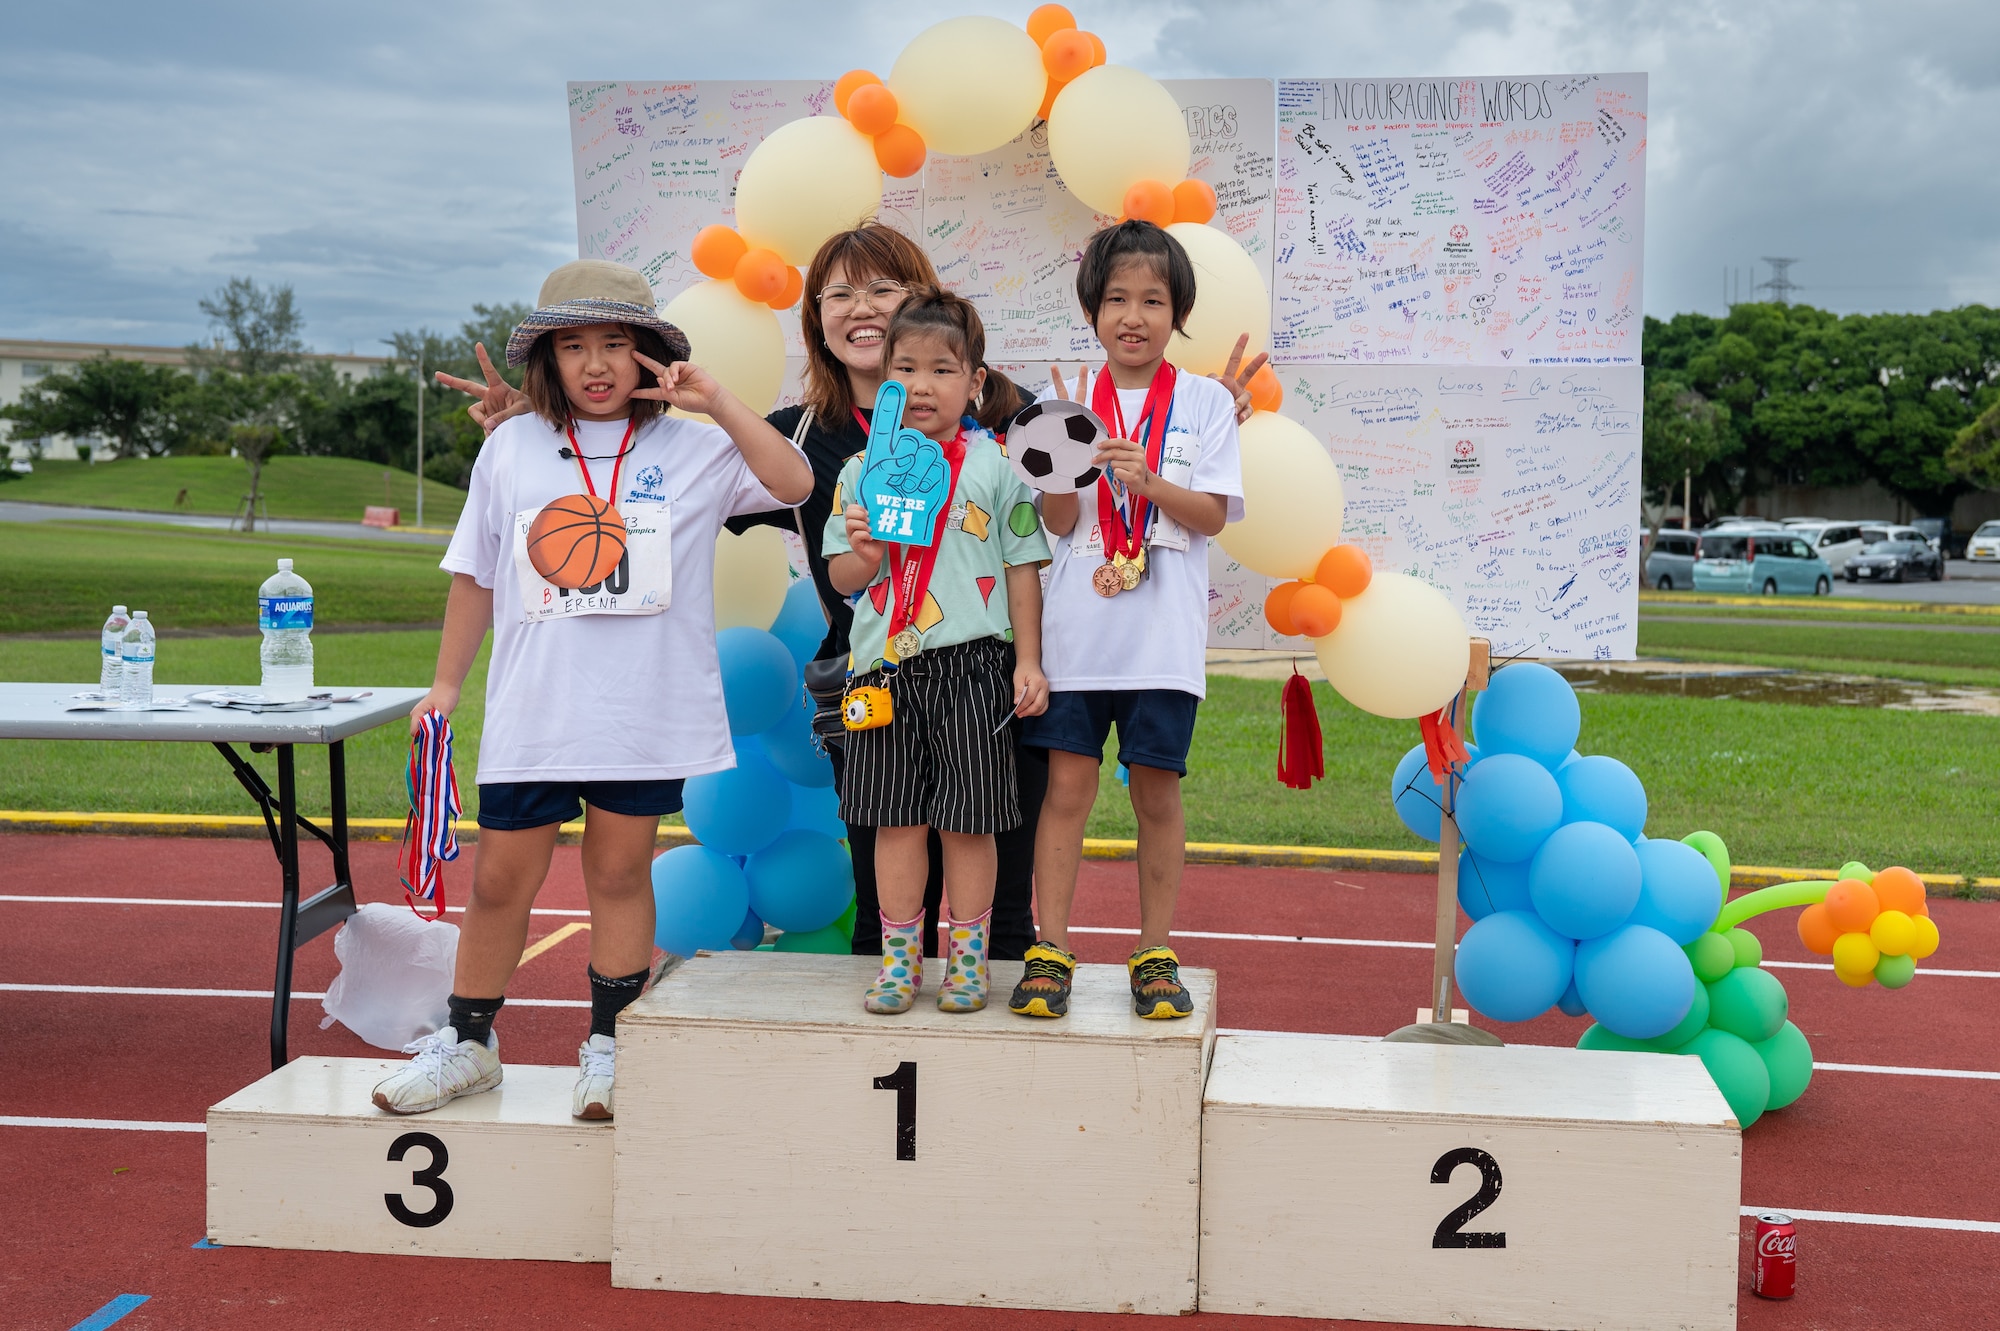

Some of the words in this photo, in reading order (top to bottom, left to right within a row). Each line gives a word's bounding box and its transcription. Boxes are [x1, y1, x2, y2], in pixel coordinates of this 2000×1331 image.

[626, 83, 639, 97] You
[643, 87, 657, 95] are
[1321, 81, 1460, 121] ENCOURAGING
[1480, 79, 1552, 122] WORDS
[1192, 140, 1244, 155] athletes
[694, 158, 708, 166] Hard
[1355, 153, 1370, 161] they
[1429, 151, 1448, 160] Fighting
[1214, 181, 1227, 193] WAY
[1228, 180, 1236, 188] TO
[1236, 178, 1245, 187] GO
[1367, 178, 1381, 188] both
[1382, 171, 1405, 183] usually
[1580, 186, 1592, 203] you
[1592, 170, 1605, 184] the
[1216, 186, 1251, 202] ATHLETES!
[1426, 207, 1459, 216] Challenge!
[1365, 216, 1381, 228] good
[1387, 216, 1403, 226] luck
[1544, 251, 1562, 262] Good
[1567, 244, 1583, 256] luck
[1586, 236, 1607, 250] with
[1549, 261, 1565, 272] your
[1569, 253, 1604, 268] olympics
[1562, 281, 1602, 300] AWESOME!
[1579, 282, 1593, 290] ARE
[1033, 290, 1051, 302] GO
[1055, 287, 1062, 299] 4
[1332, 297, 1344, 305] You
[1036, 298, 1068, 312] GOLD!
[1555, 308, 1577, 317] good
[1349, 319, 1369, 335] Go
[1378, 323, 1417, 343] Special
[1003, 336, 1049, 350] AMAZING
[1362, 349, 1375, 361] You
[1298, 377, 1312, 389] You
[1331, 379, 1423, 404] Encouraging
[1438, 376, 1484, 392] Words
[1529, 376, 1551, 396] Our
[1559, 373, 1602, 399] Special
[1294, 386, 1305, 397] got
[1351, 406, 1373, 417] Progress
[1361, 417, 1374, 427] You
[1166, 446, 1183, 458] T3
[1505, 443, 1526, 459] good
[1530, 445, 1551, 454] luck
[1348, 463, 1369, 472] believe
[1515, 456, 1535, 467] and
[630, 489, 666, 502] Special
[876, 494, 926, 512] WE'RE
[1441, 499, 1463, 512] Good
[1465, 496, 1484, 508] Luck
[877, 507, 914, 537] #1
[625, 527, 657, 535] lympics
[1089, 524, 1100, 542] B
[1578, 535, 1599, 548] GOOD
[1600, 529, 1619, 540] LUCK
[1424, 543, 1435, 552] GO
[1489, 545, 1516, 557] HAVE
[903, 559, 912, 582] WORLD
[1536, 562, 1545, 571] Do
[1463, 580, 1485, 589] Never
[1487, 581, 1502, 589] Give
[1607, 580, 1618, 590] You
[1619, 572, 1627, 581] are
[275, 601, 313, 613] AQUARIUS
[543, 587, 552, 605] B
[565, 596, 617, 613] ERENA
[641, 590, 657, 606] 10
[1466, 594, 1487, 604] Best
[1491, 597, 1501, 605] of
[1503, 596, 1521, 606] Luck
[1501, 605, 1522, 614] rock!
[1551, 611, 1562, 621] You
[1561, 606, 1571, 619] got
[1216, 617, 1238, 637] Good
[1239, 602, 1257, 619] Luck
[1574, 620, 1593, 633] KEEP
[1594, 616, 1605, 628] UP
[1606, 612, 1621, 622] THE
[1585, 630, 1605, 641] HARD
[872, 1060, 918, 1163] 1
[384, 1131, 455, 1229] 3
[1430, 1146, 1507, 1250] 2
